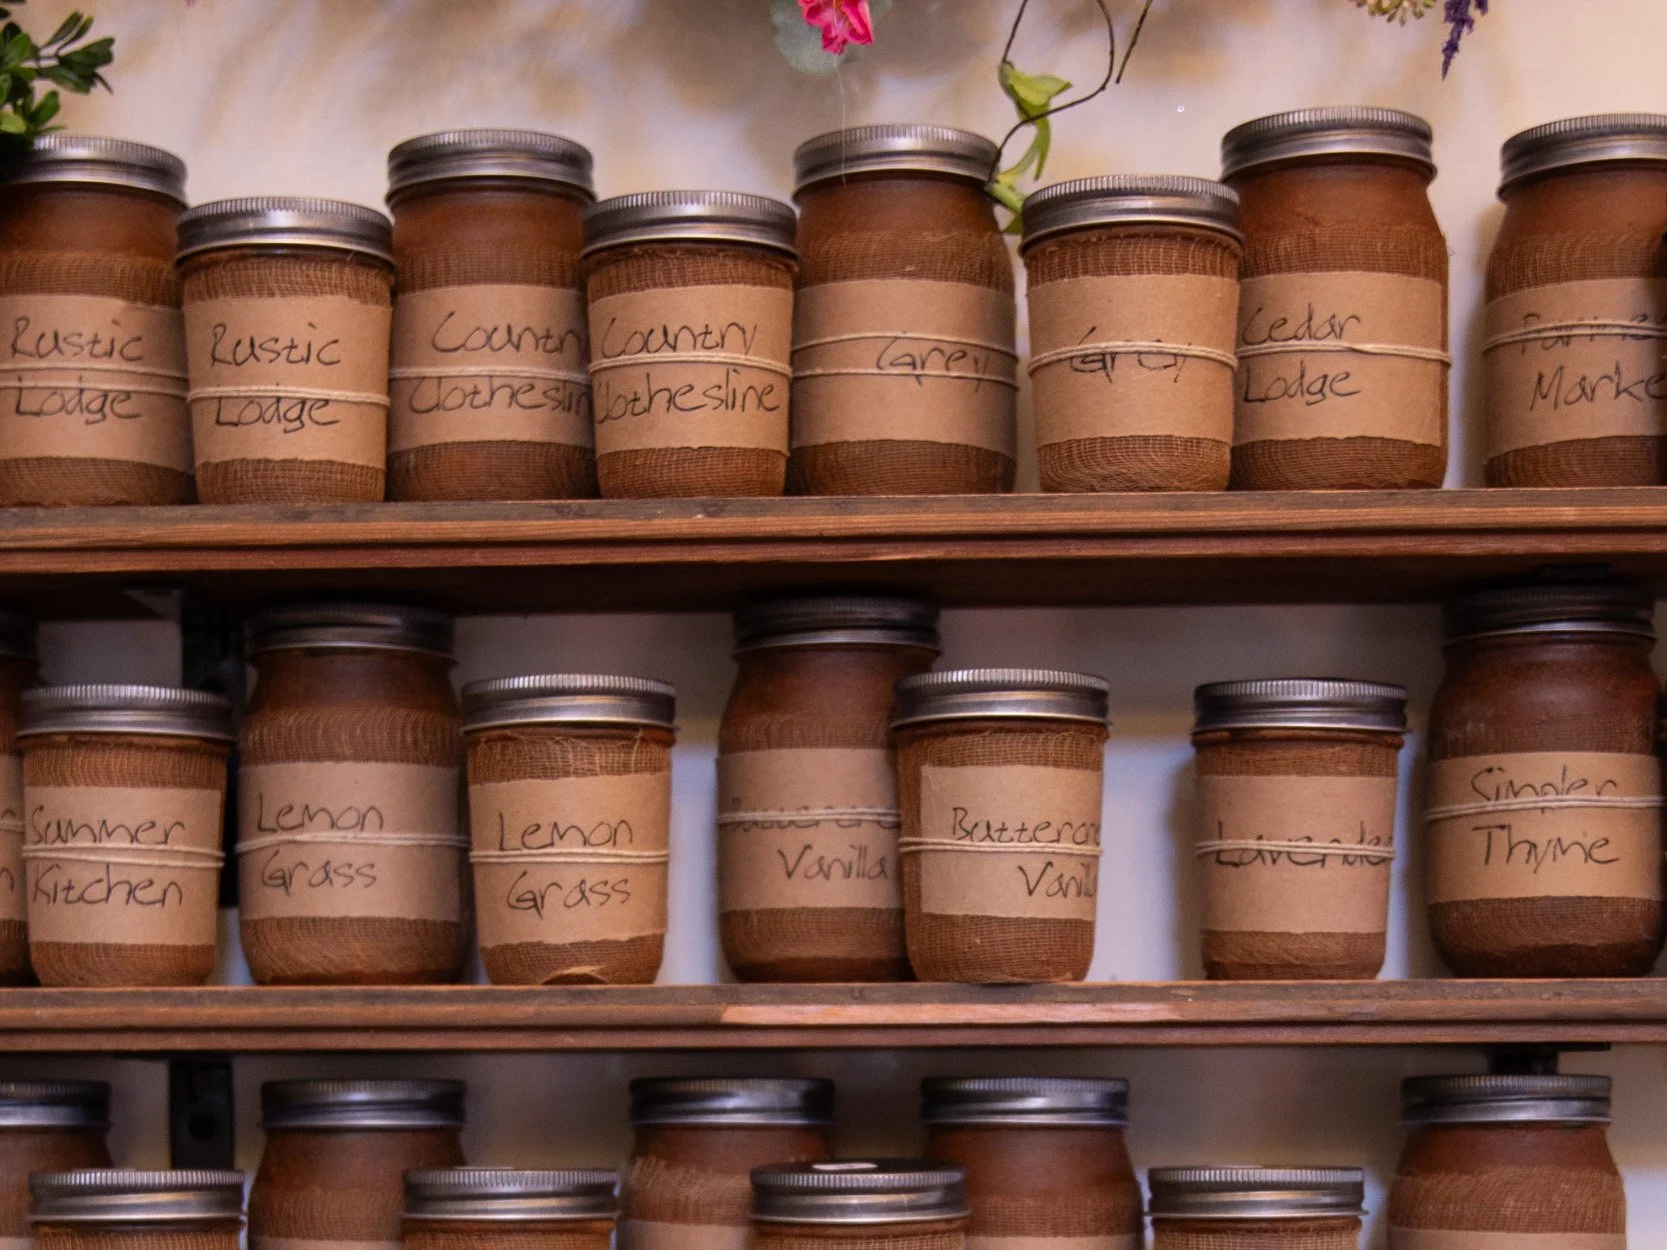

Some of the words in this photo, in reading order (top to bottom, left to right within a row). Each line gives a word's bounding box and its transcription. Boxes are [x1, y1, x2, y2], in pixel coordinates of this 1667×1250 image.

[10, 316, 145, 361] Rustic
[209, 321, 342, 368] Rustic
[601, 317, 757, 358] Country
[1241, 303, 1361, 346] Cedar
[14, 375, 141, 426] Lodge
[1243, 359, 1361, 407] Lodge
[214, 384, 341, 434] Lodge
[256, 793, 385, 834] Lemon
[499, 811, 634, 851] Lemon
[777, 844, 890, 881] Vanilla
[1471, 824, 1620, 874] Thyme
[32, 862, 184, 909] Kitchen
[260, 849, 378, 898] Grass
[506, 870, 631, 920] Grass
